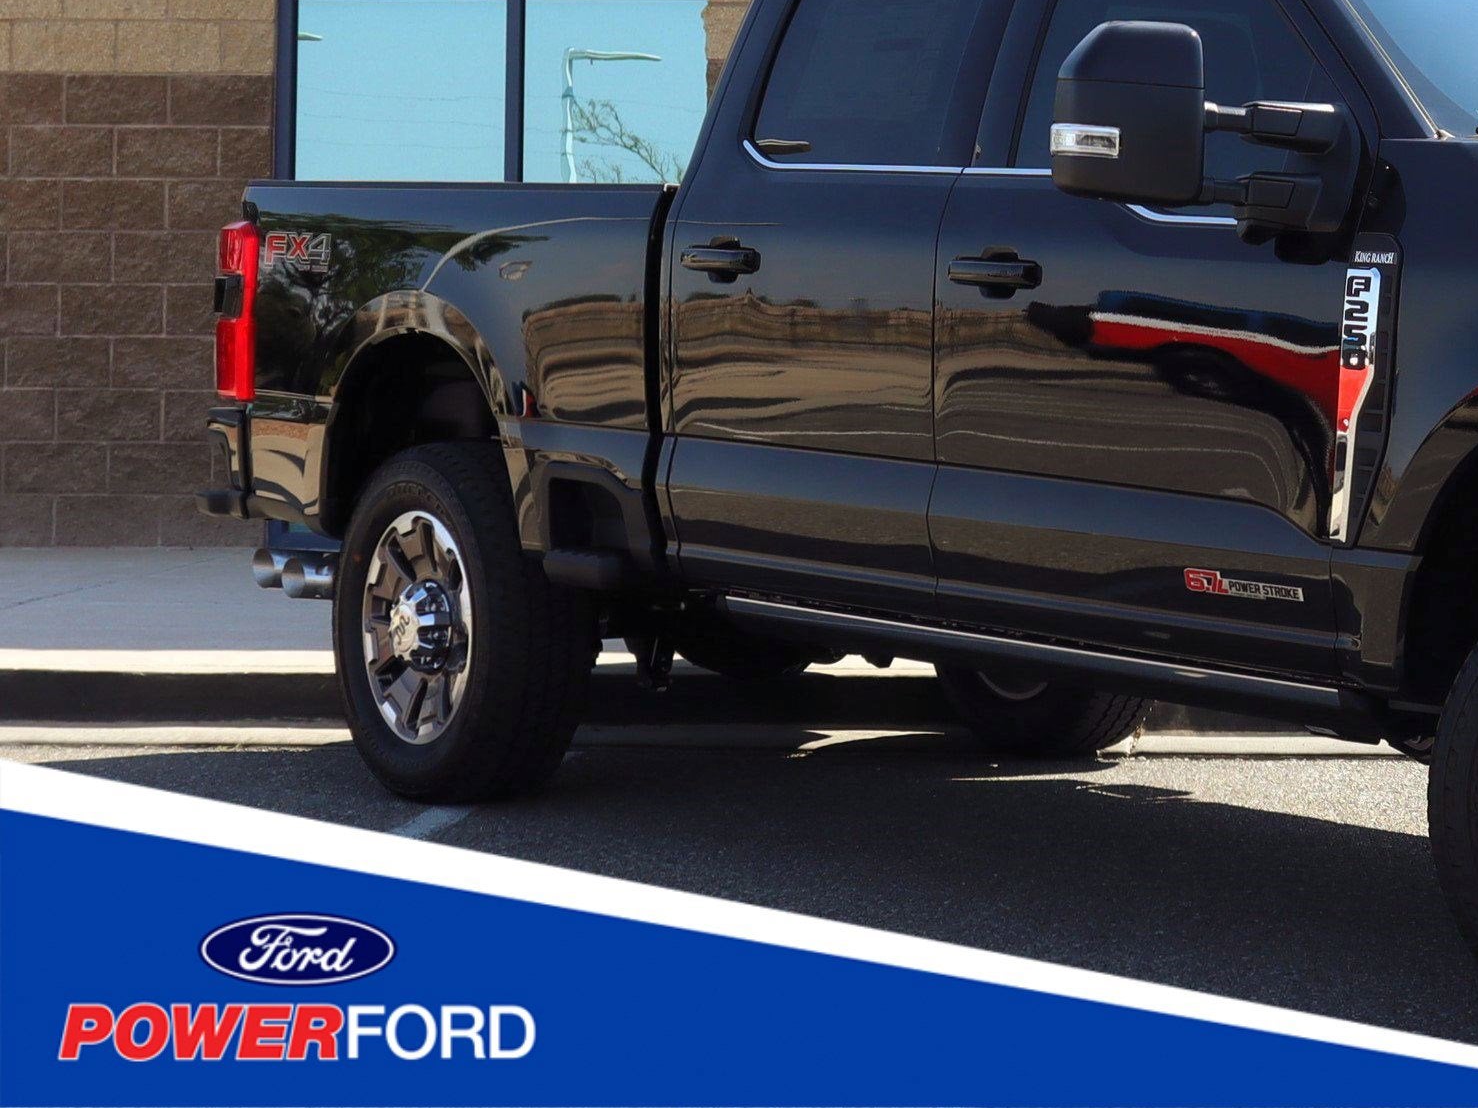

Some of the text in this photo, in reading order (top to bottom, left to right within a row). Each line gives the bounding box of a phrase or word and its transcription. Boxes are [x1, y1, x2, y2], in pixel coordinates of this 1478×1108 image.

[263, 231, 331, 268] FX4
[1354, 251, 1394, 264] KING RANCH
[1228, 580, 1261, 595] POWER
[1262, 585, 1300, 600] STROKE
